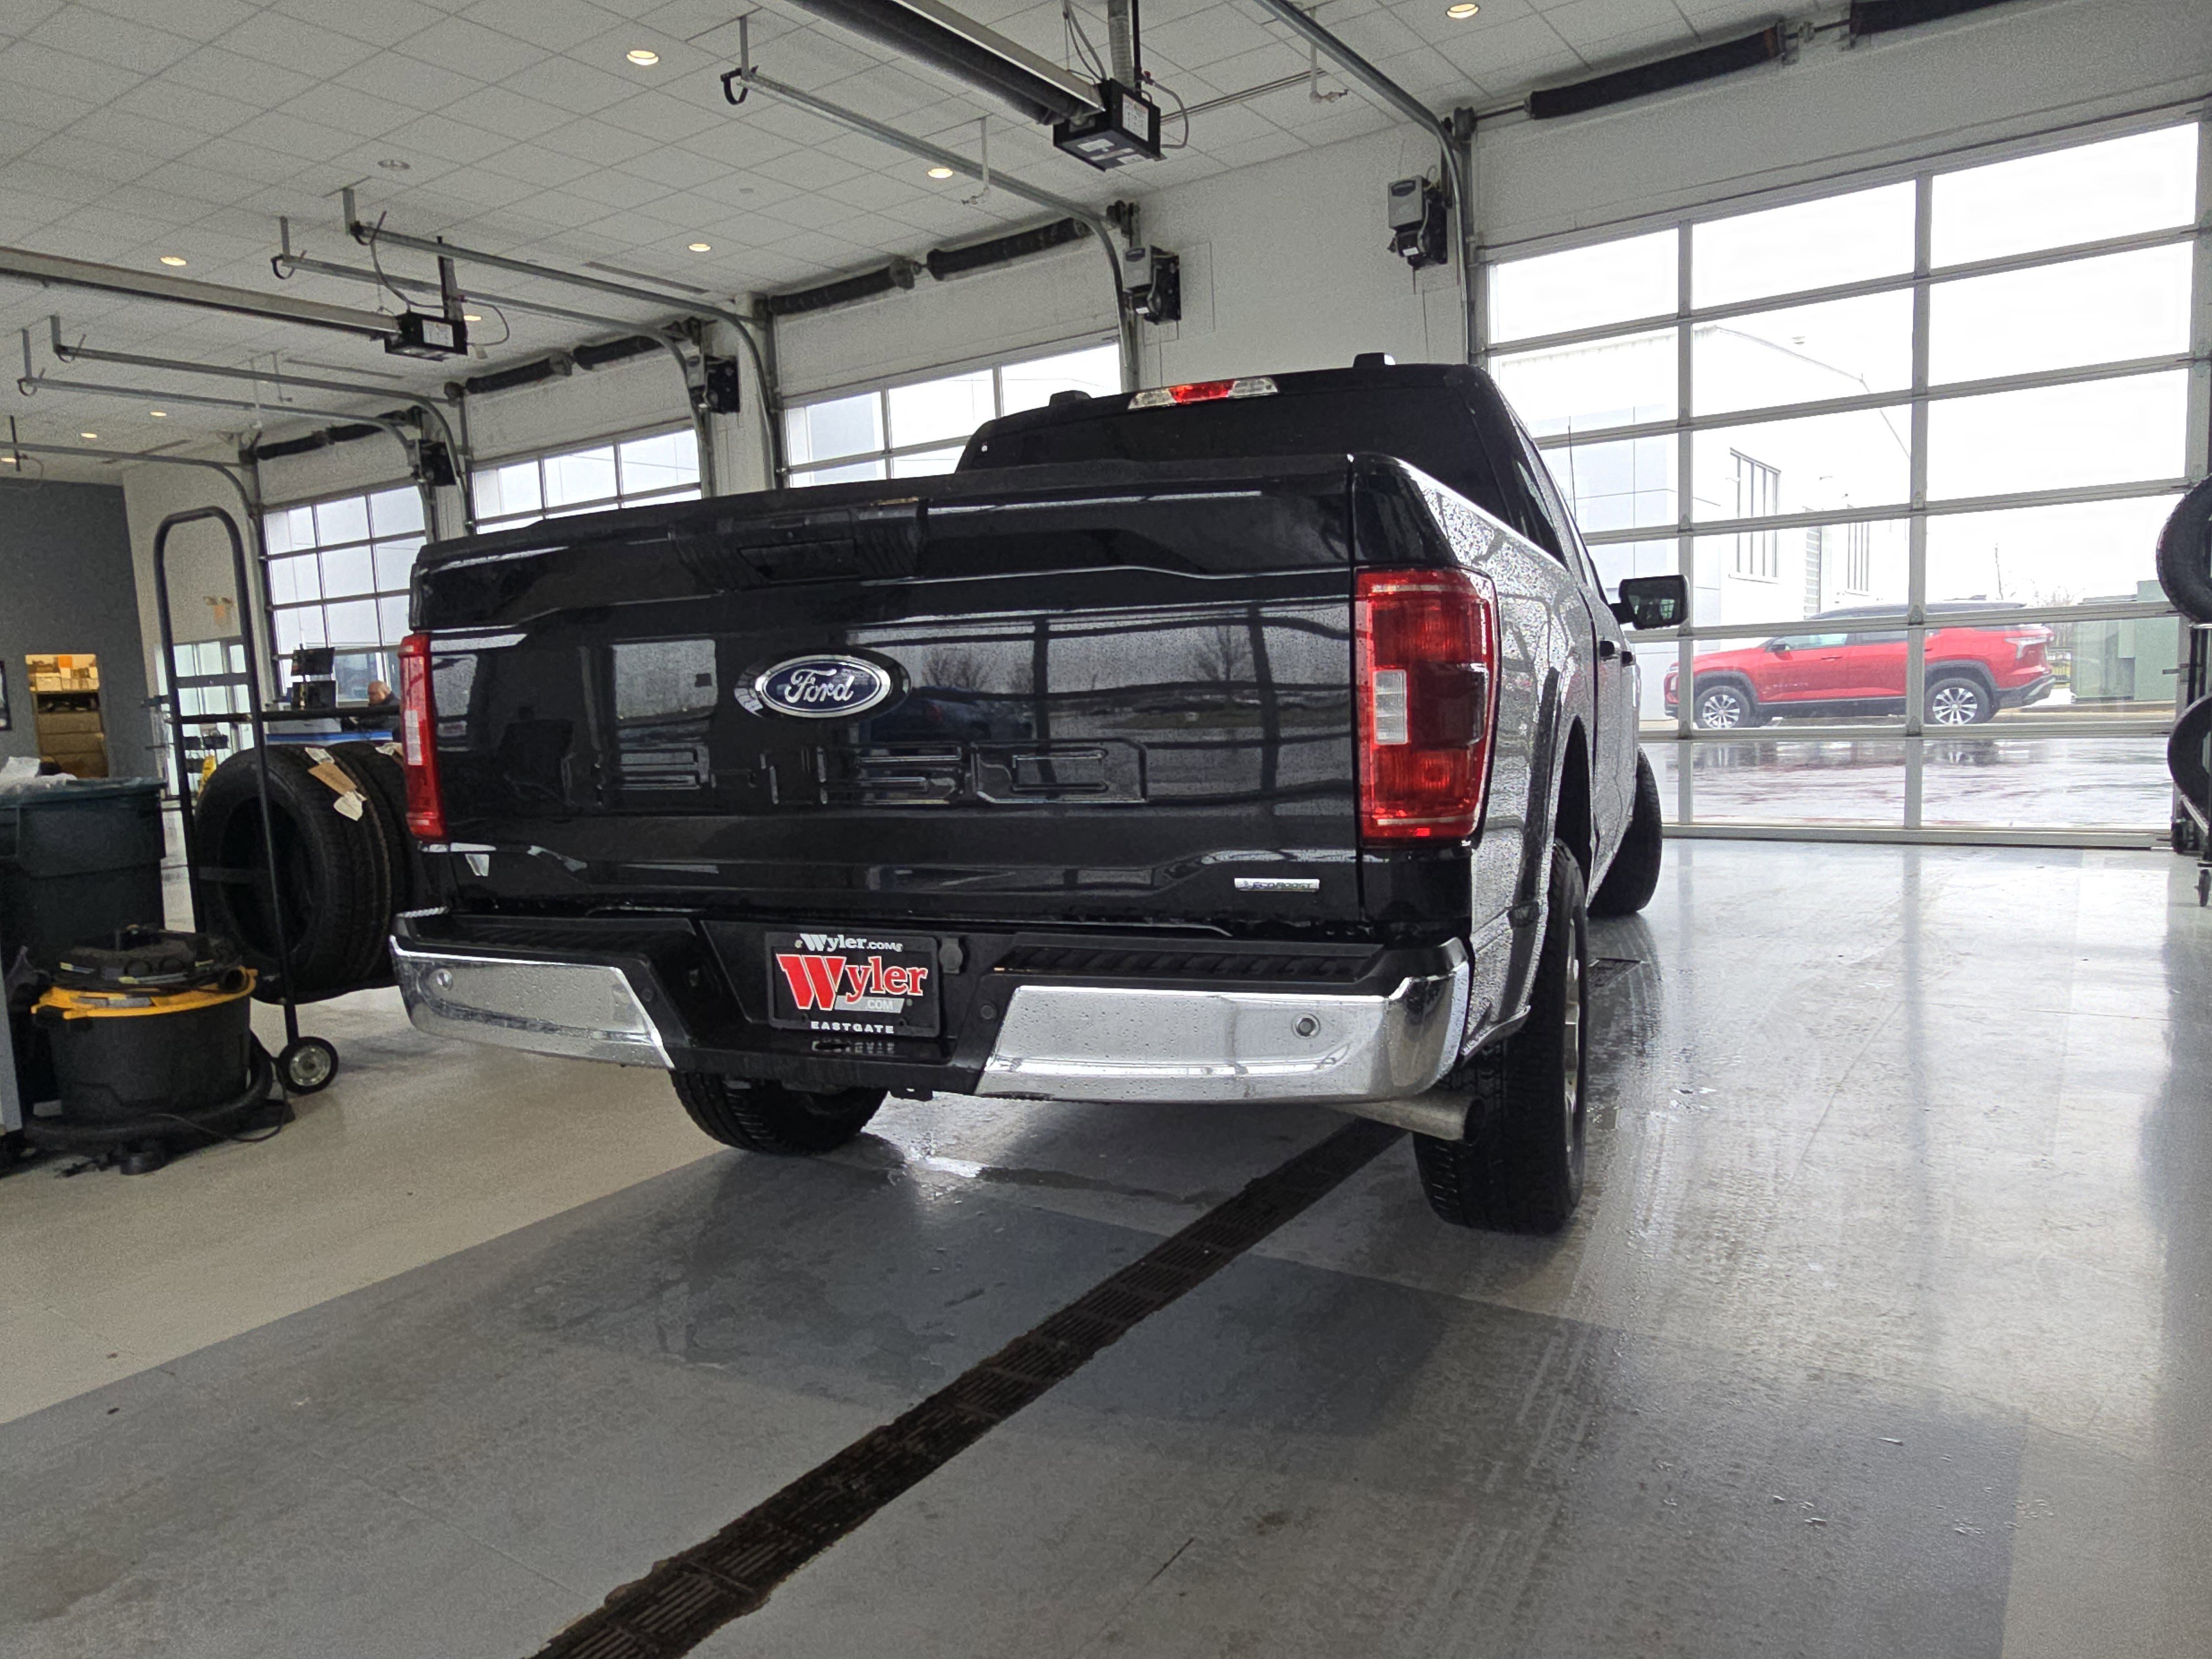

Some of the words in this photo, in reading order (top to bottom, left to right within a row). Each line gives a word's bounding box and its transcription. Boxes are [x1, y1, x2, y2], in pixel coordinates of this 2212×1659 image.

[784, 668, 854, 703] Ford
[775, 953, 928, 1011] Wyler
[810, 1020, 895, 1034] EASTGATE
